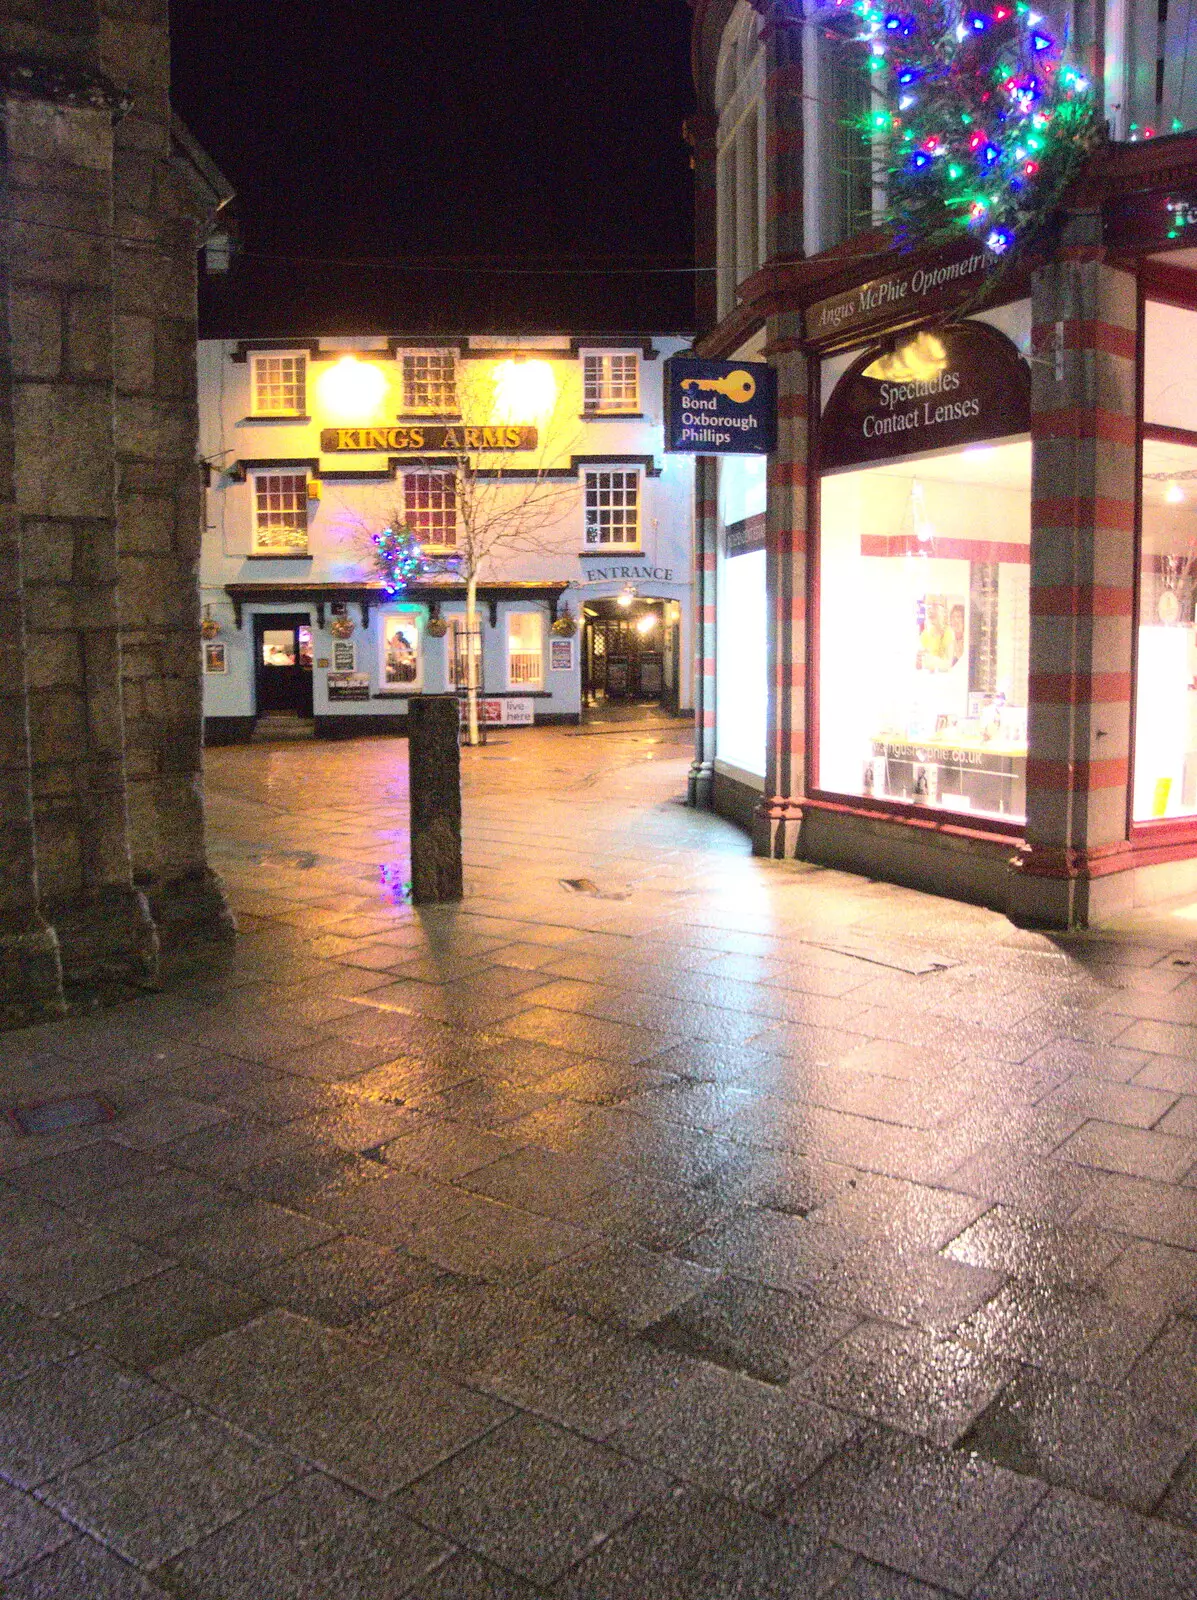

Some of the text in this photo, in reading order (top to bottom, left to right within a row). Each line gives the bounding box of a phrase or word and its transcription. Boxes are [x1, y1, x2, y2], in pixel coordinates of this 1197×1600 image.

[818, 301, 855, 327] Angus
[858, 279, 908, 313] McPhie
[880, 371, 960, 410] Spectacles
[681, 395, 717, 410] Bond
[681, 412, 758, 431] Oxborough
[863, 398, 980, 438] Contact Lenses
[336, 427, 522, 450] KINGS ARMS
[681, 428, 731, 446] Phillips
[586, 566, 673, 582] ENTRANCE
